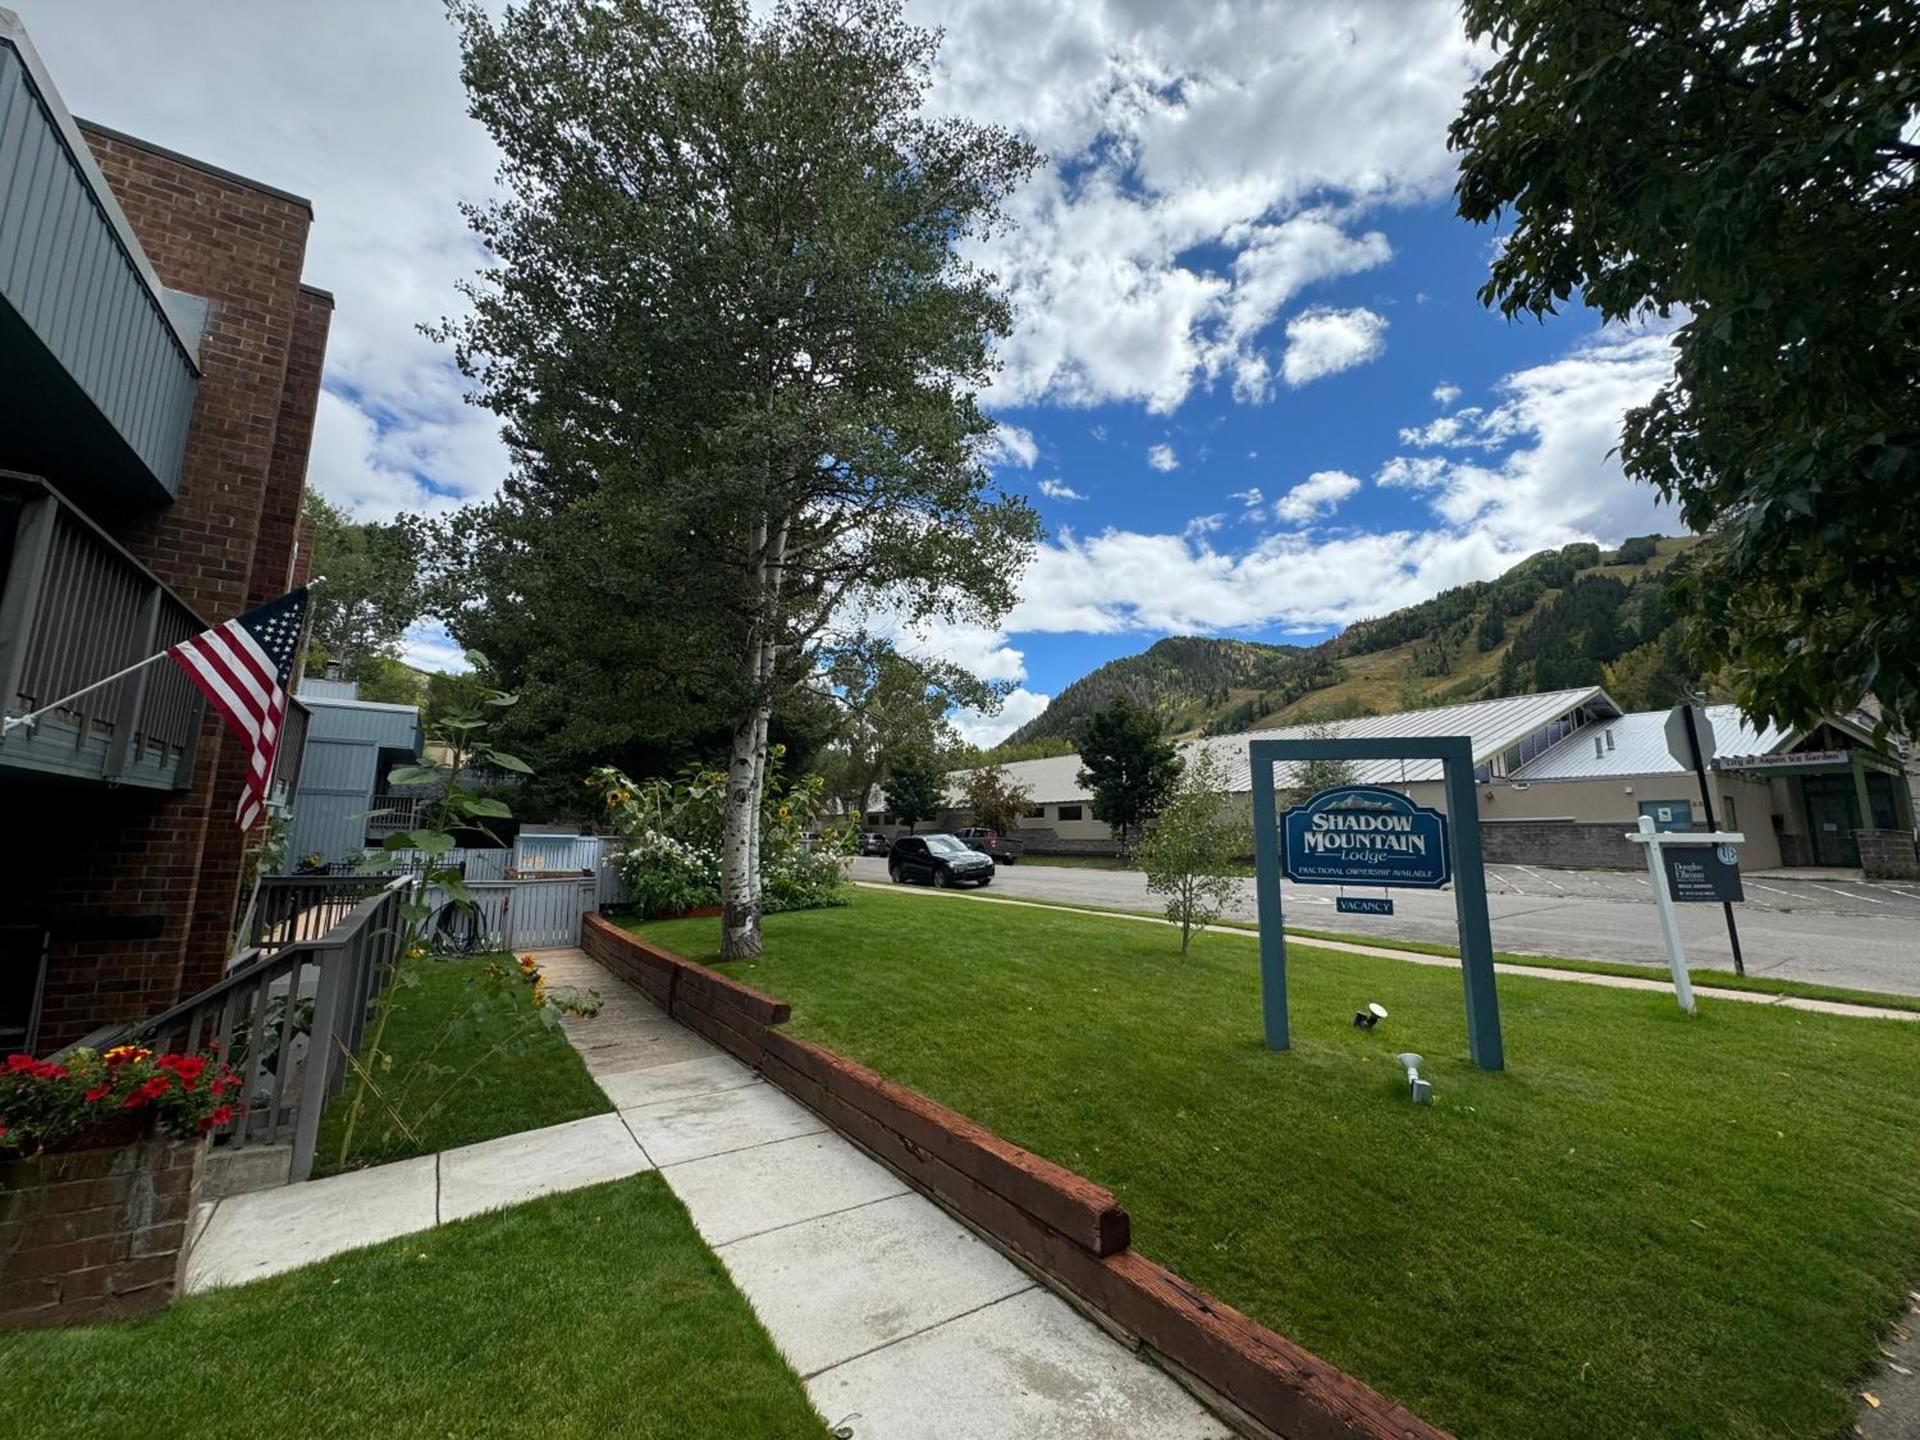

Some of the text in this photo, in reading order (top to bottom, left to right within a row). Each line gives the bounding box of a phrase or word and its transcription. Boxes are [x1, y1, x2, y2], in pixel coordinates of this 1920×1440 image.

[1805, 754, 1839, 762] Garden
[1341, 850, 1388, 864] Lodge
[1298, 866, 1433, 878] FRACTIONAL OWNERSHIP AVAILABLE
[1340, 901, 1390, 912] VACANCY
